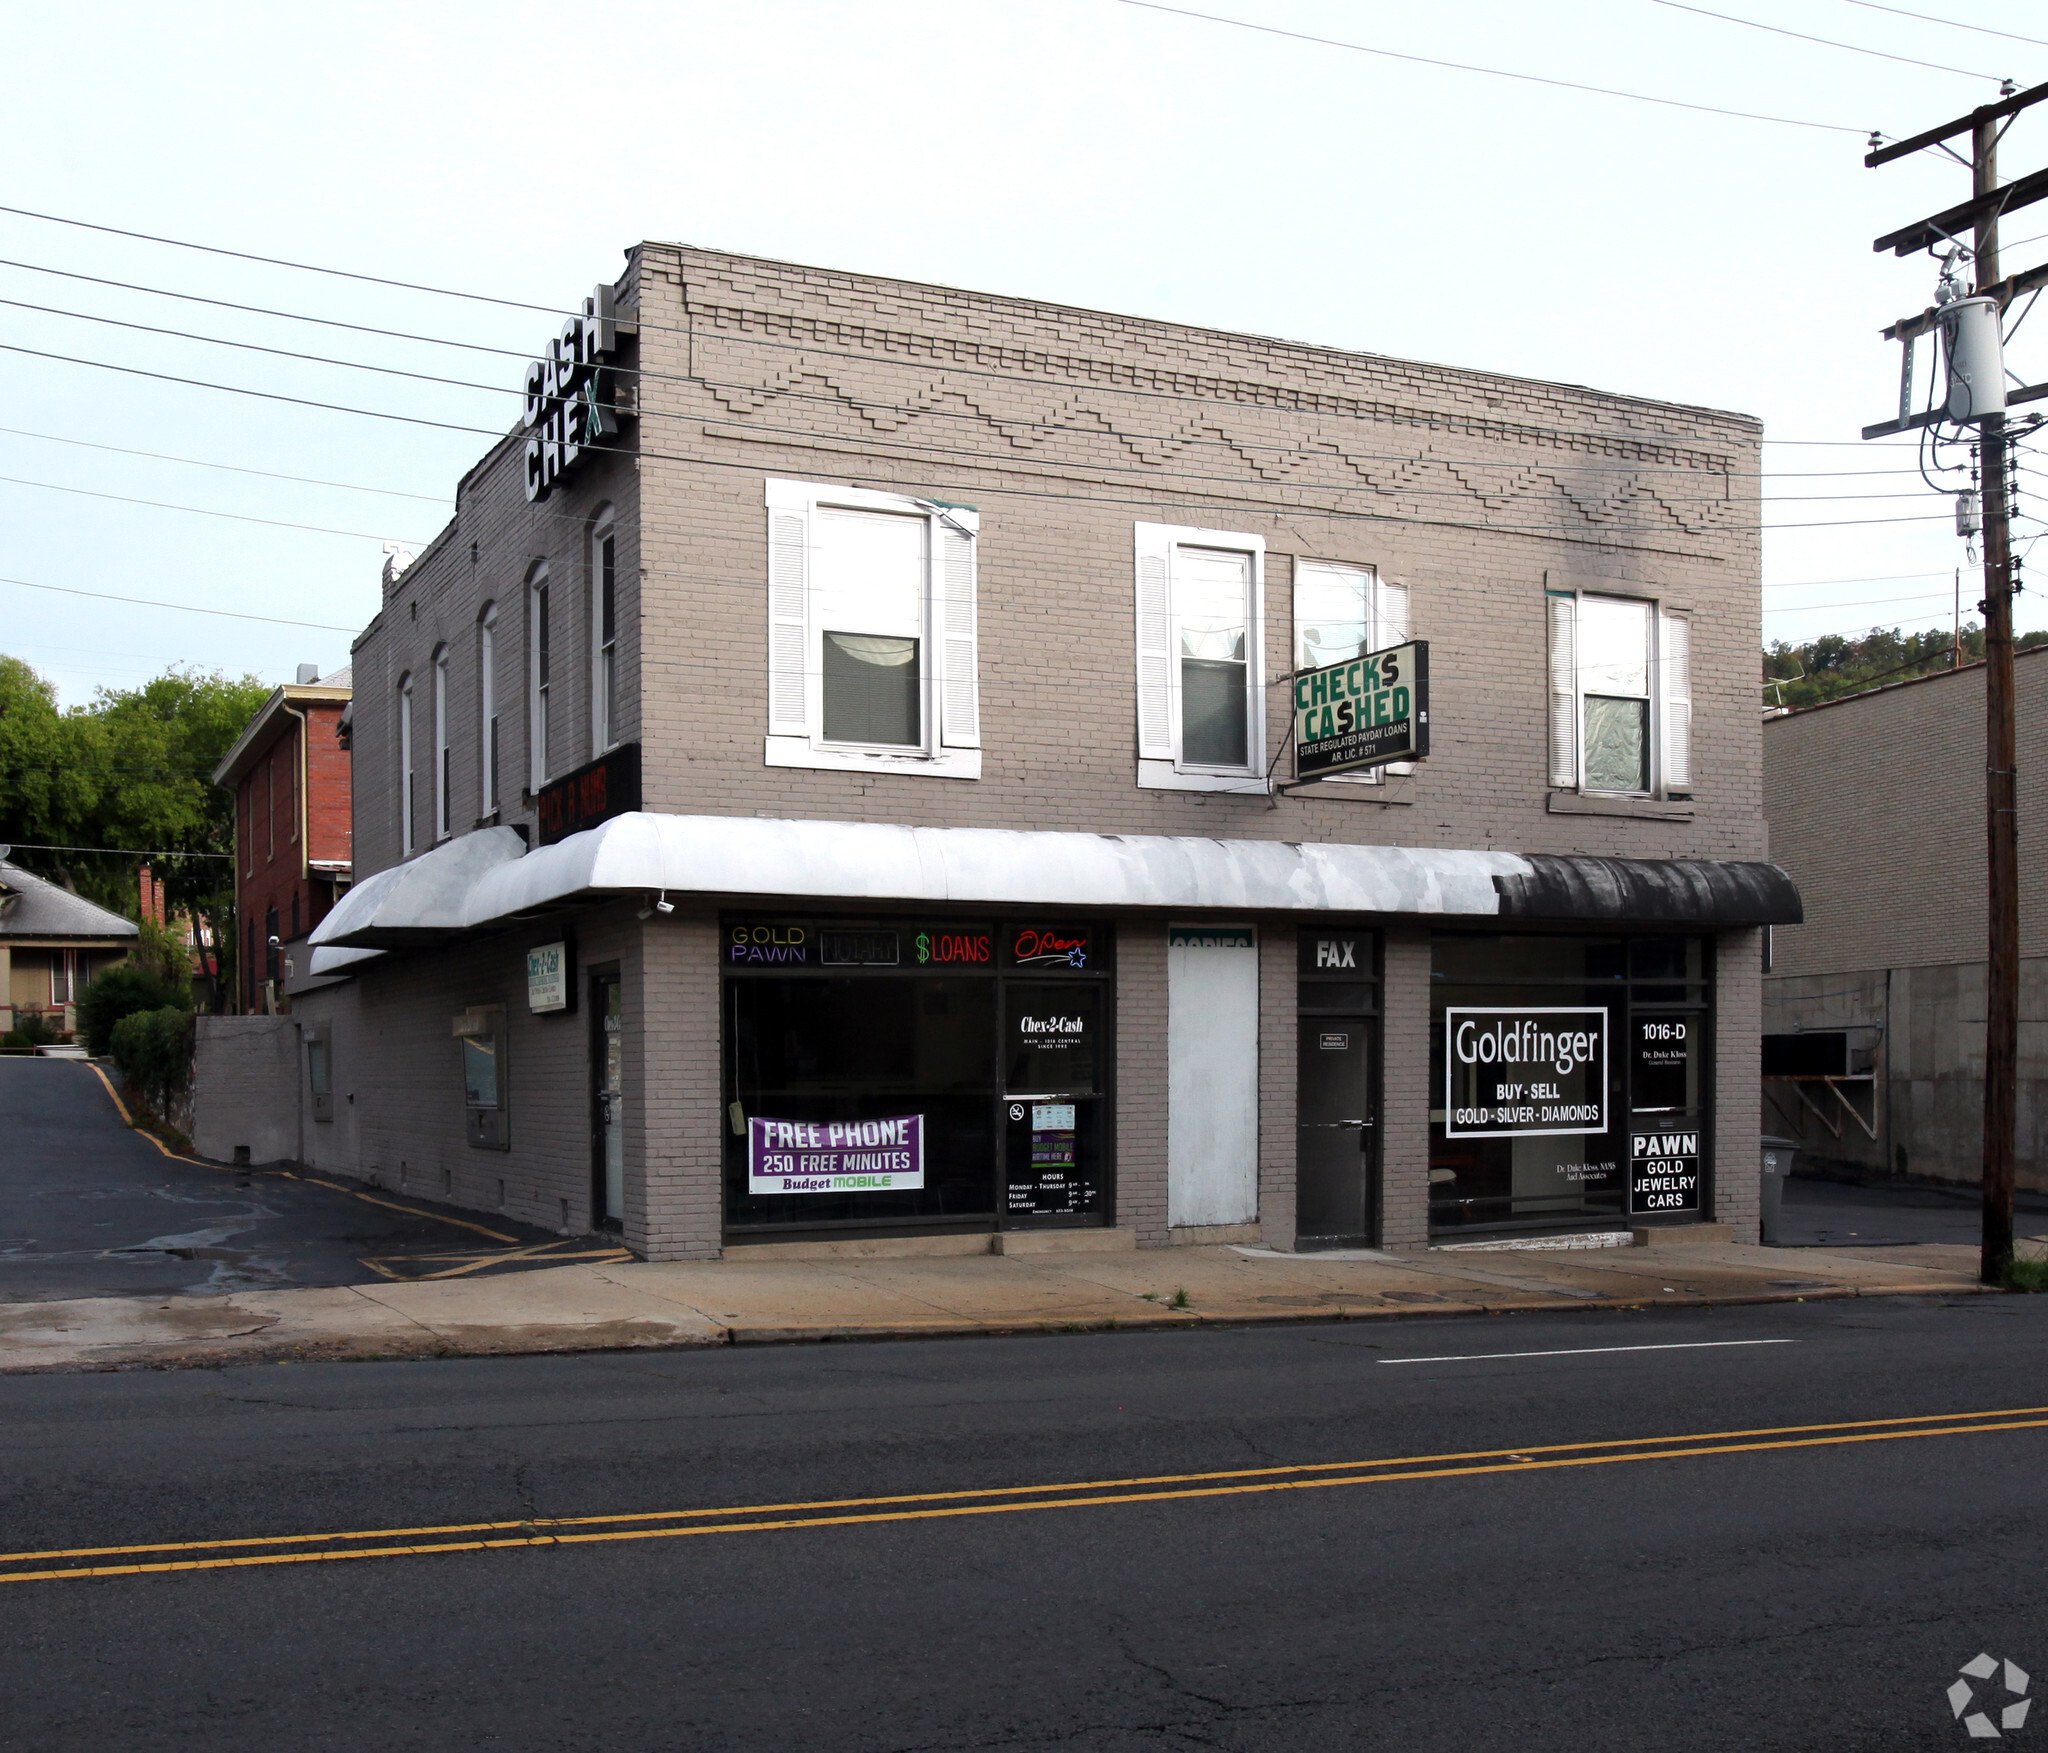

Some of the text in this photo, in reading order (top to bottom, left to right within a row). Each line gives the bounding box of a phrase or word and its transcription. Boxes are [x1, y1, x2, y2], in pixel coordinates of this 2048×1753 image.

[523, 283, 602, 428] CASH
[525, 367, 603, 502] CHEX
[1300, 722, 1408, 756] STATE REGULATED PAYDAY LOANS
[1332, 751, 1342, 763] AR.
[1344, 748, 1357, 761] LIC.
[1364, 744, 1376, 757] 571
[732, 926, 805, 944] GOLD
[731, 944, 806, 962] PAWN
[1317, 940, 1356, 967] FAX
[1020, 1016, 1083, 1032] Chex-2-Cash
[1642, 1023, 1686, 1040] 1016-D
[1456, 1020, 1598, 1075] Goldfinger
[1496, 1083, 1523, 1100] BUY
[1530, 1083, 1560, 1099] SELL
[1456, 1107, 1488, 1124] GOLD
[1497, 1106, 1534, 1123] SILVER
[1541, 1104, 1599, 1122] DIAMONDS
[764, 1119, 910, 1148] FREE PHONE
[1633, 1134, 1697, 1157] PAWN
[763, 1152, 910, 1173] 250 FREE MINUTES
[1647, 1160, 1684, 1175] GOLD
[783, 1175, 892, 1191] Budget MOBILE
[1634, 1176, 1696, 1192] JEWELRY
[1647, 1193, 1683, 1208] CARS
